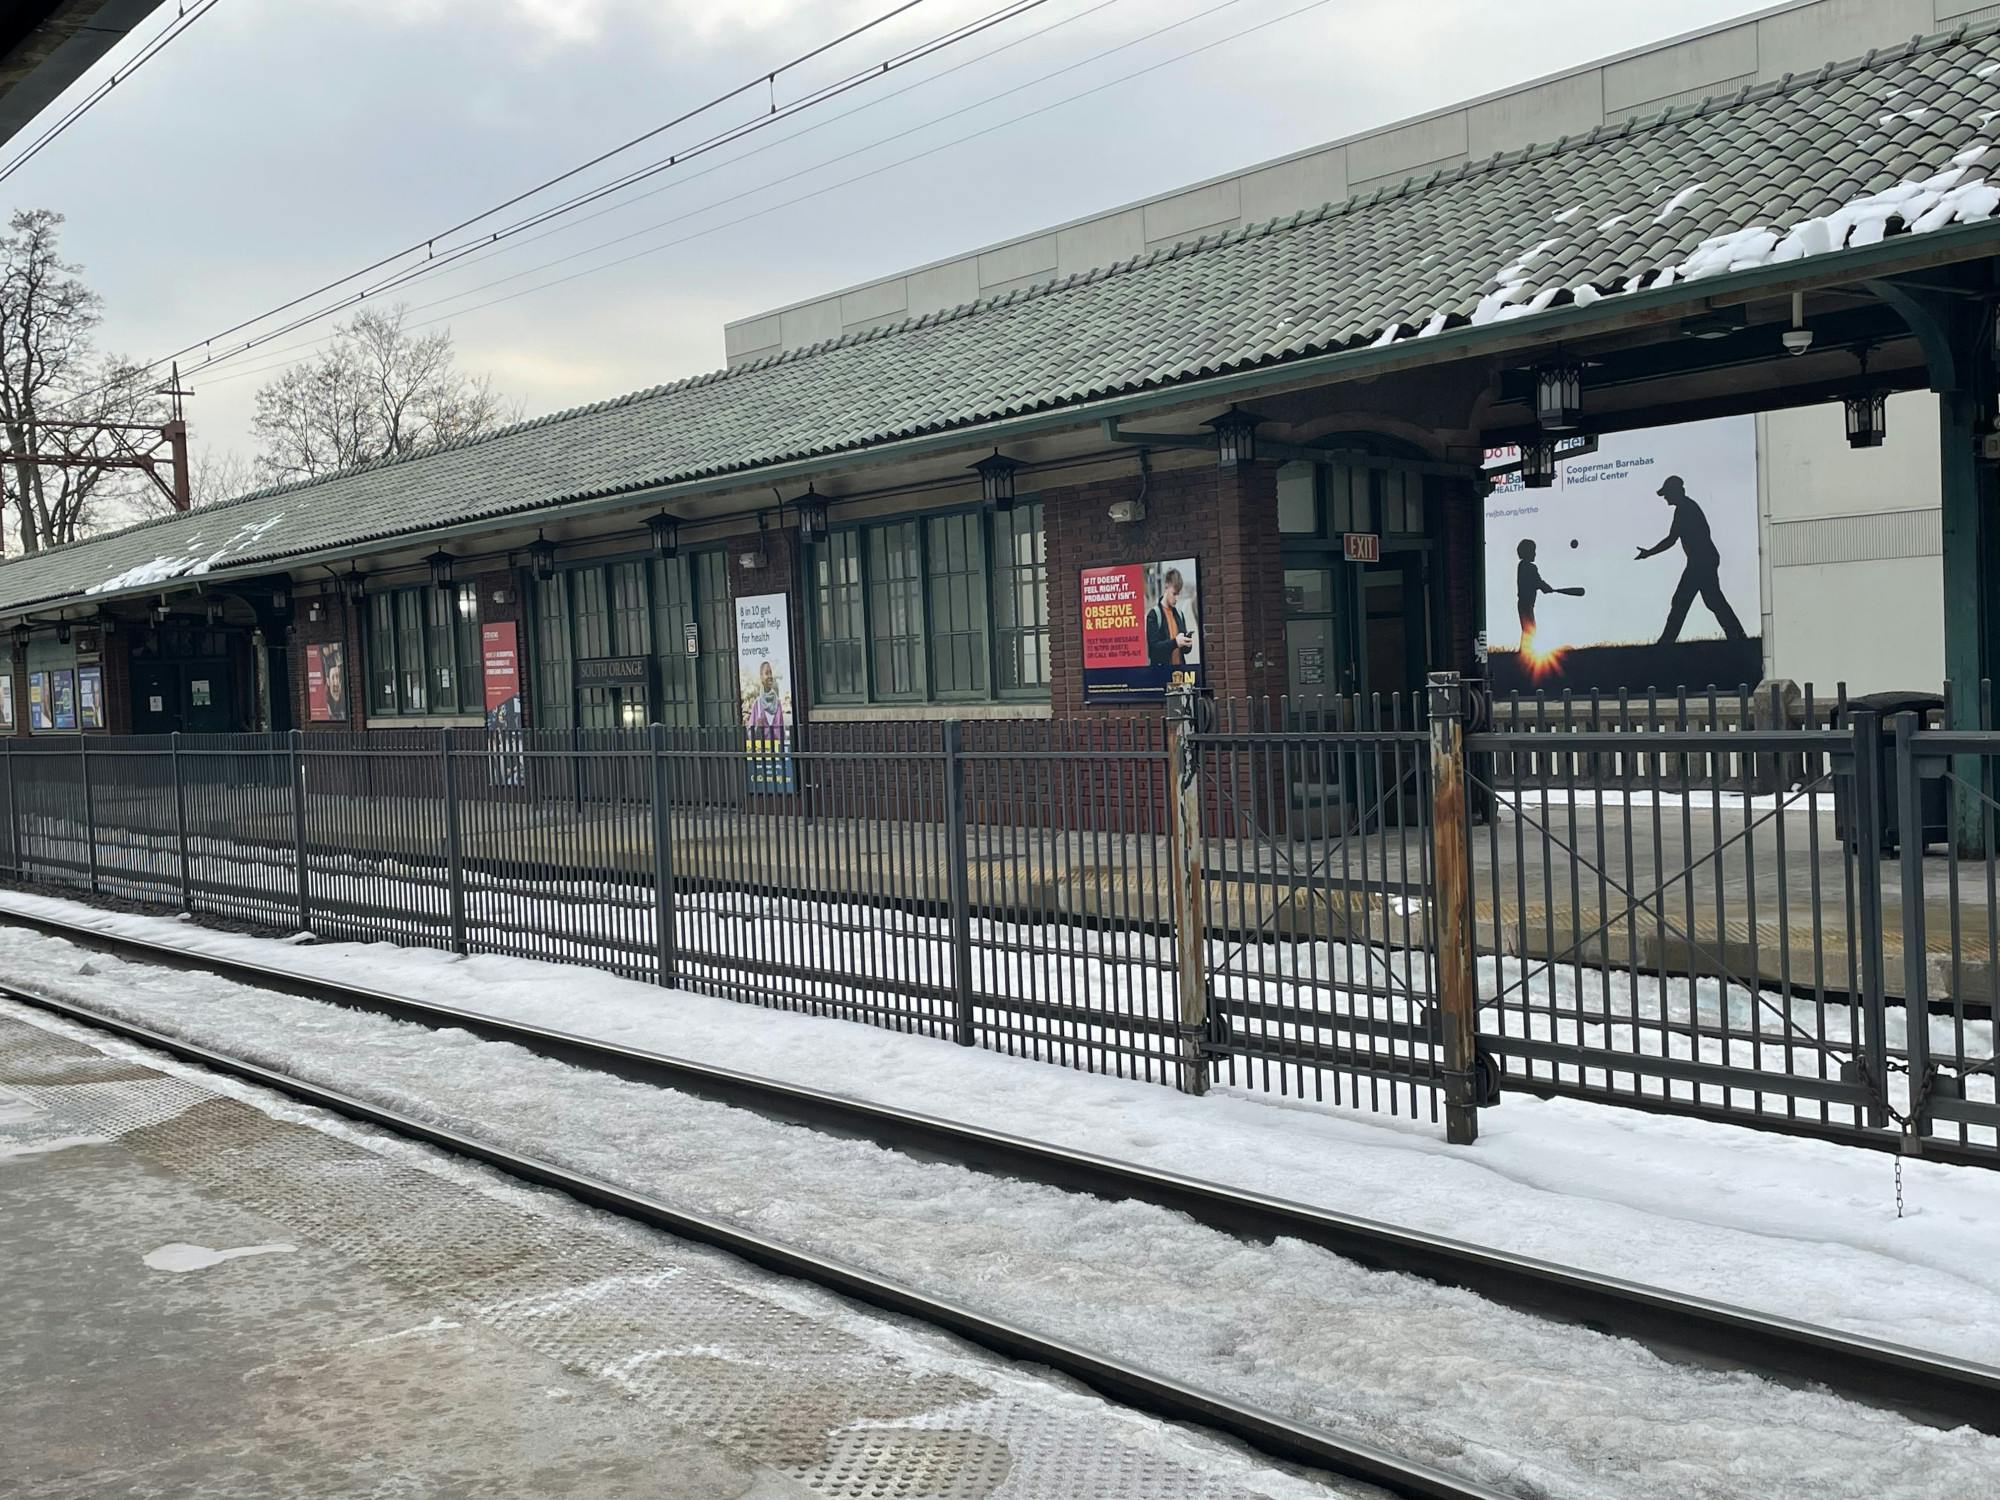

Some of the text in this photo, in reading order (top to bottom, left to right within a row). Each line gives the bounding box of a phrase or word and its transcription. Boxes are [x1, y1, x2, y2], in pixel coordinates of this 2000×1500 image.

[1566, 457, 1655, 475] Cooperman Barnabas
[1567, 473, 1598, 485] Medical
[1600, 471, 1629, 481] Center
[1494, 484, 1524, 494] HEALTH
[1350, 536, 1373, 559] EXIT
[1090, 577, 1096, 585] IT
[1097, 574, 1126, 584] DOESN'T
[1084, 583, 1129, 594] FEEL RIGHT, IT
[1084, 591, 1137, 603] PROBABLY ISN'T.
[751, 605, 759, 616] 10
[760, 605, 771, 618] get
[1085, 604, 1132, 617] OBSERVE
[767, 617, 781, 630] help
[1086, 616, 1138, 630] & REPORT.
[751, 631, 770, 642] health
[581, 661, 643, 678] SOUTH ORANGE
